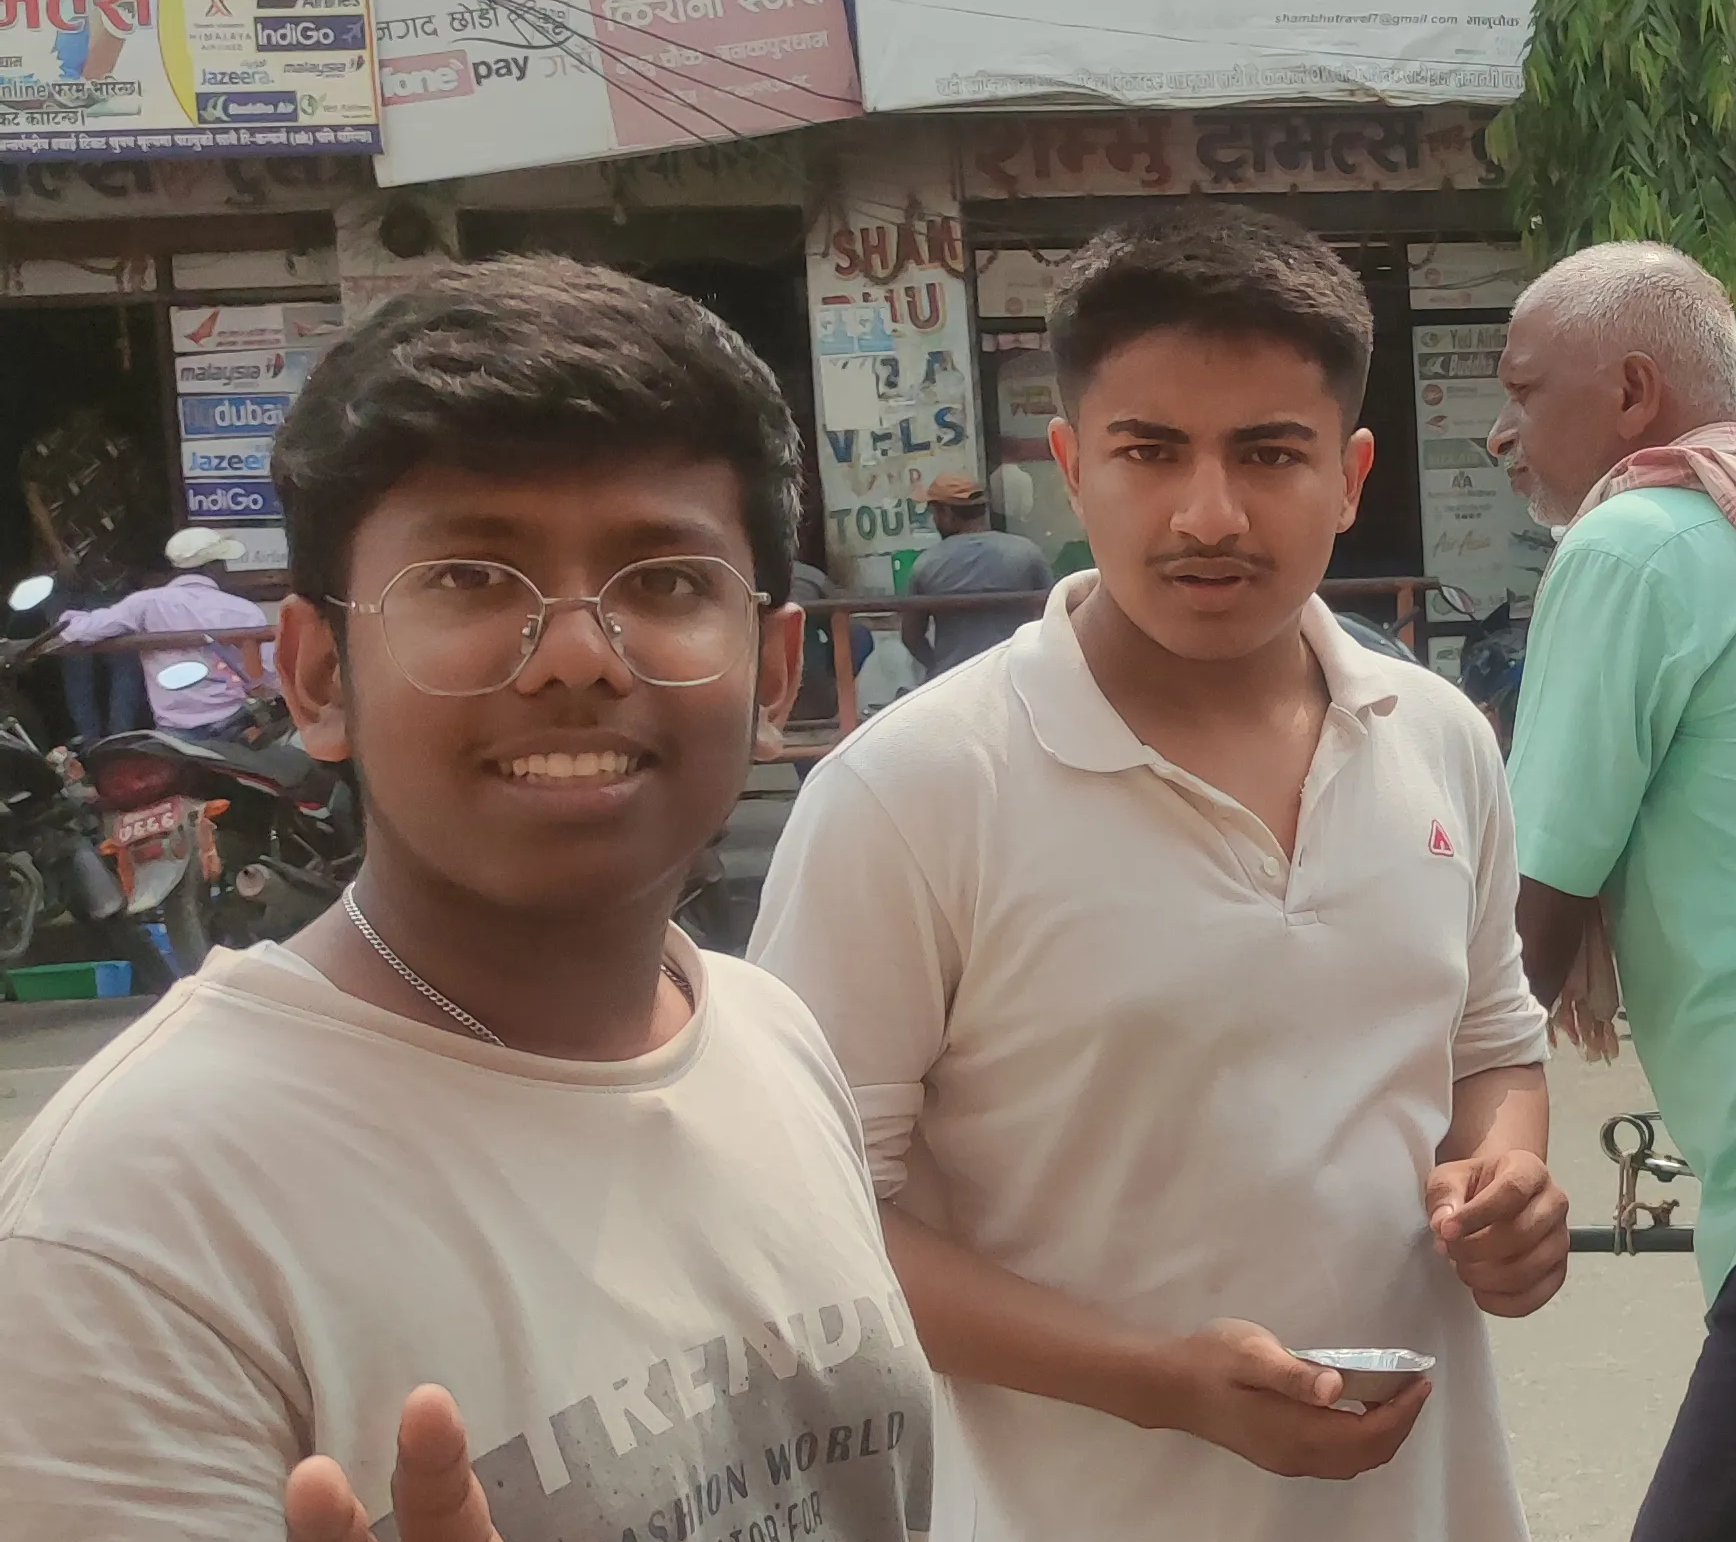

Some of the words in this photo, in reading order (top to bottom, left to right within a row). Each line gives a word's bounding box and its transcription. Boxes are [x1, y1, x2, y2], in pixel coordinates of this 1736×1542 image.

[256, 21, 335, 46] IndiGo
[180, 362, 261, 386] malaysia
[188, 487, 264, 511] IndiGo
[766, 1411, 905, 1487] WORLD
